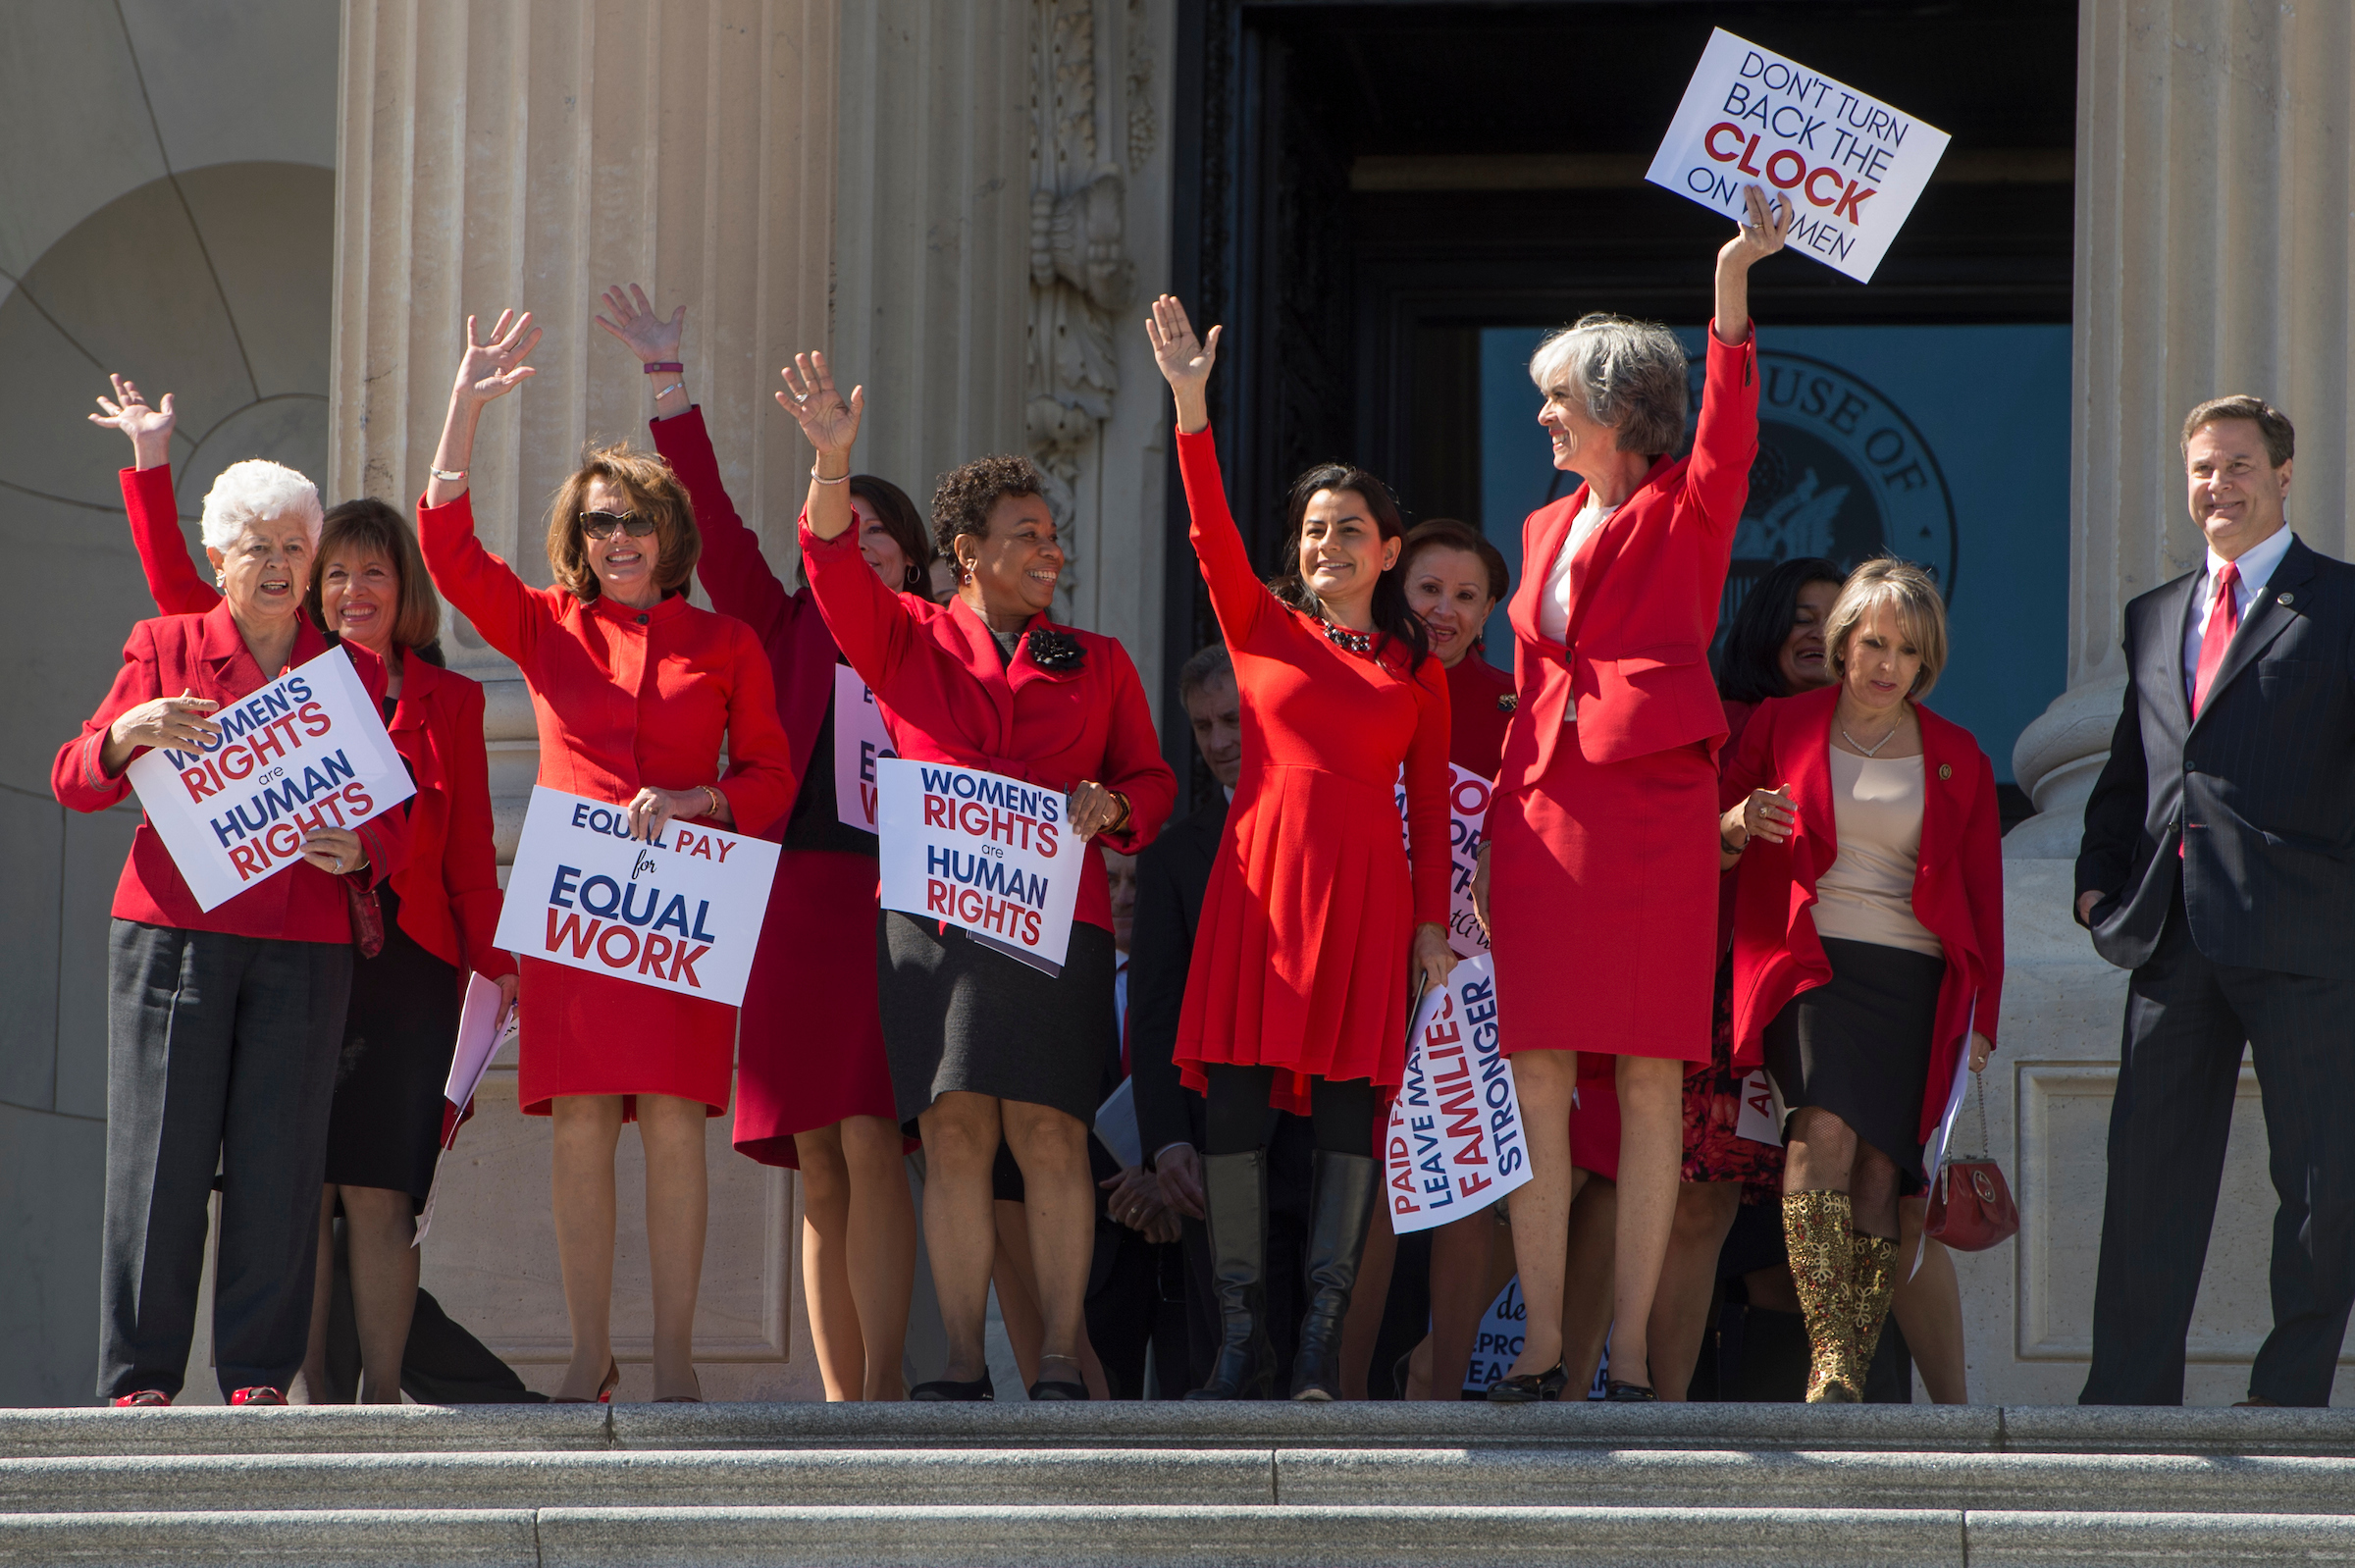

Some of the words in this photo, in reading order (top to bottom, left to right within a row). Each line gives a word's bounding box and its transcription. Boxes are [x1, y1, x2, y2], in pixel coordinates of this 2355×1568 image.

[1722, 81, 1827, 151] BACK
[1830, 128, 1895, 183] THE
[1739, 51, 1833, 109] DON'T
[1837, 92, 1910, 148] TURN
[1687, 167, 1738, 207] ON
[1704, 122, 1878, 227] CLOCK
[1864, 429, 1928, 494] OF
[180, 702, 332, 805] RIGHTS
[258, 765, 285, 786] are
[210, 749, 356, 849] HUMAN
[228, 782, 374, 882] RIGHTS
[920, 767, 1059, 822] WOMEN'S
[923, 794, 1059, 859] RIGHTS
[631, 849, 657, 880] for
[675, 829, 737, 863] PAY
[927, 845, 1049, 910] HUMAN
[981, 843, 1004, 859] are
[549, 863, 715, 944] EQUAL
[927, 878, 1042, 946] RIGHTS
[545, 907, 711, 989] WORK
[1425, 993, 1492, 1199] FAMILIES
[1461, 975, 1522, 1177] STRONGER
[1388, 1136, 1421, 1216] PAID
[1411, 1114, 1454, 1210] LEAVE
